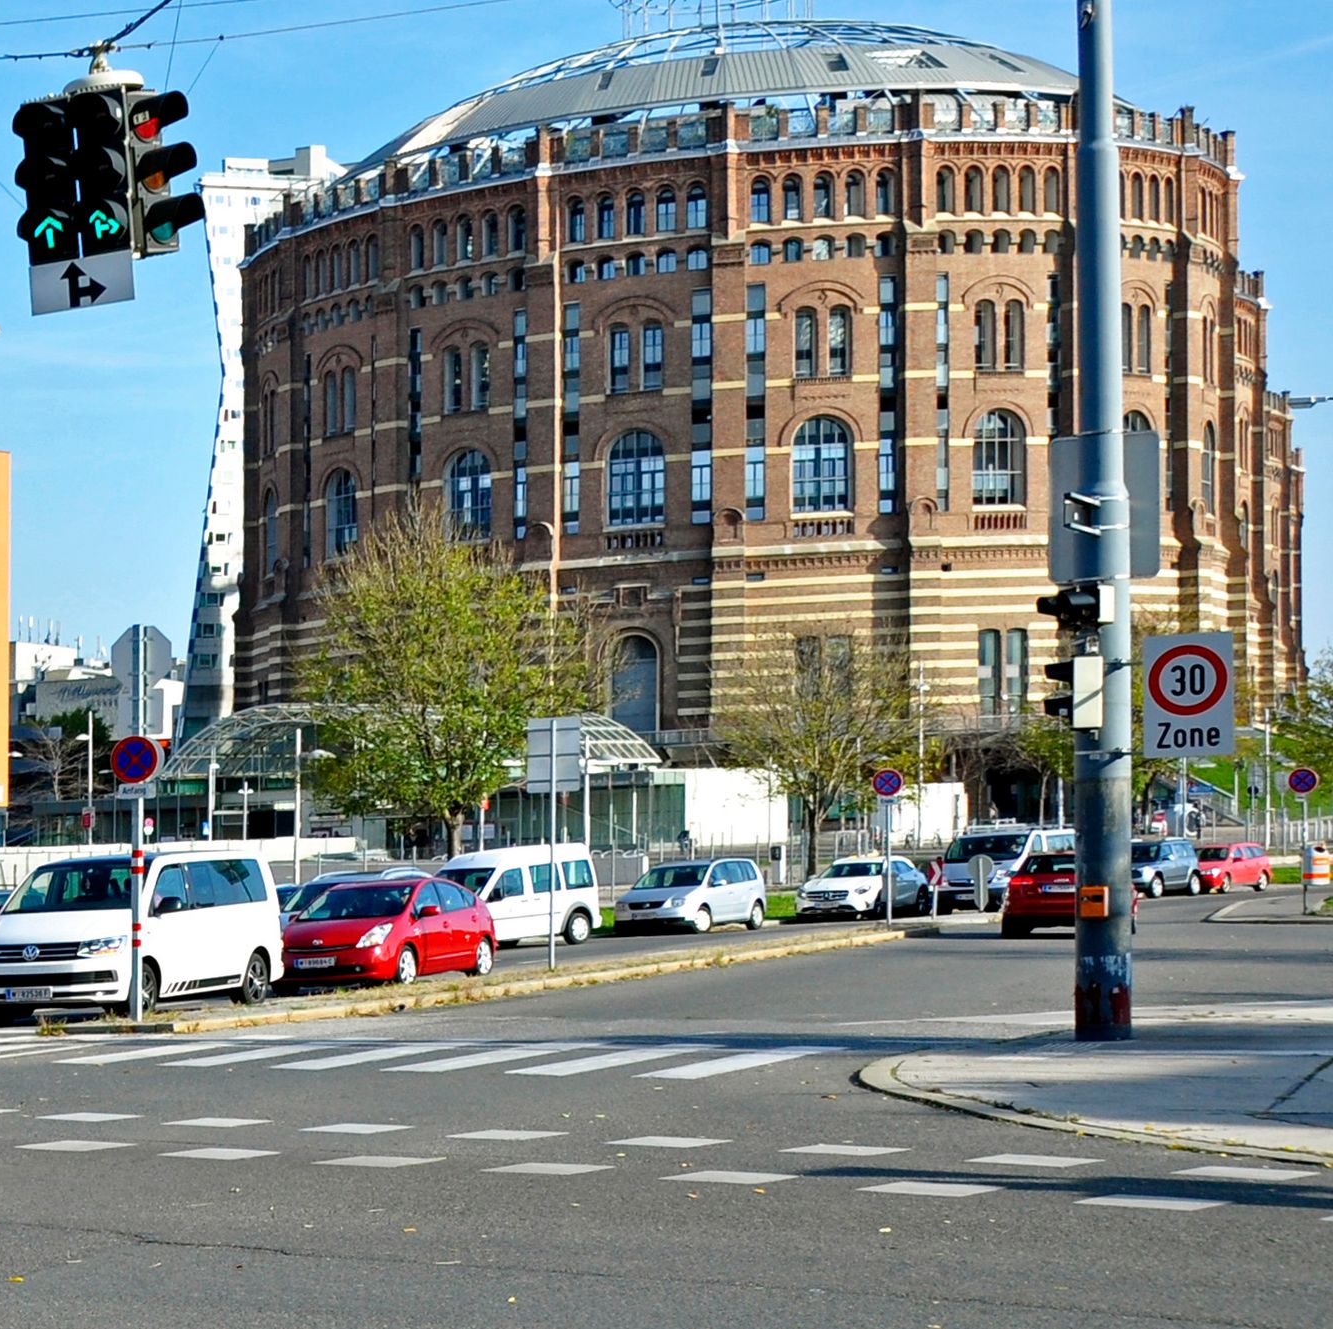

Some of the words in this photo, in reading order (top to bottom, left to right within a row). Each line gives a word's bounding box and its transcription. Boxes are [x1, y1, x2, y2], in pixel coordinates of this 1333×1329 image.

[1171, 664, 1205, 696] 30
[1157, 722, 1220, 749] Zone
[122, 786, 146, 796] Anfang
